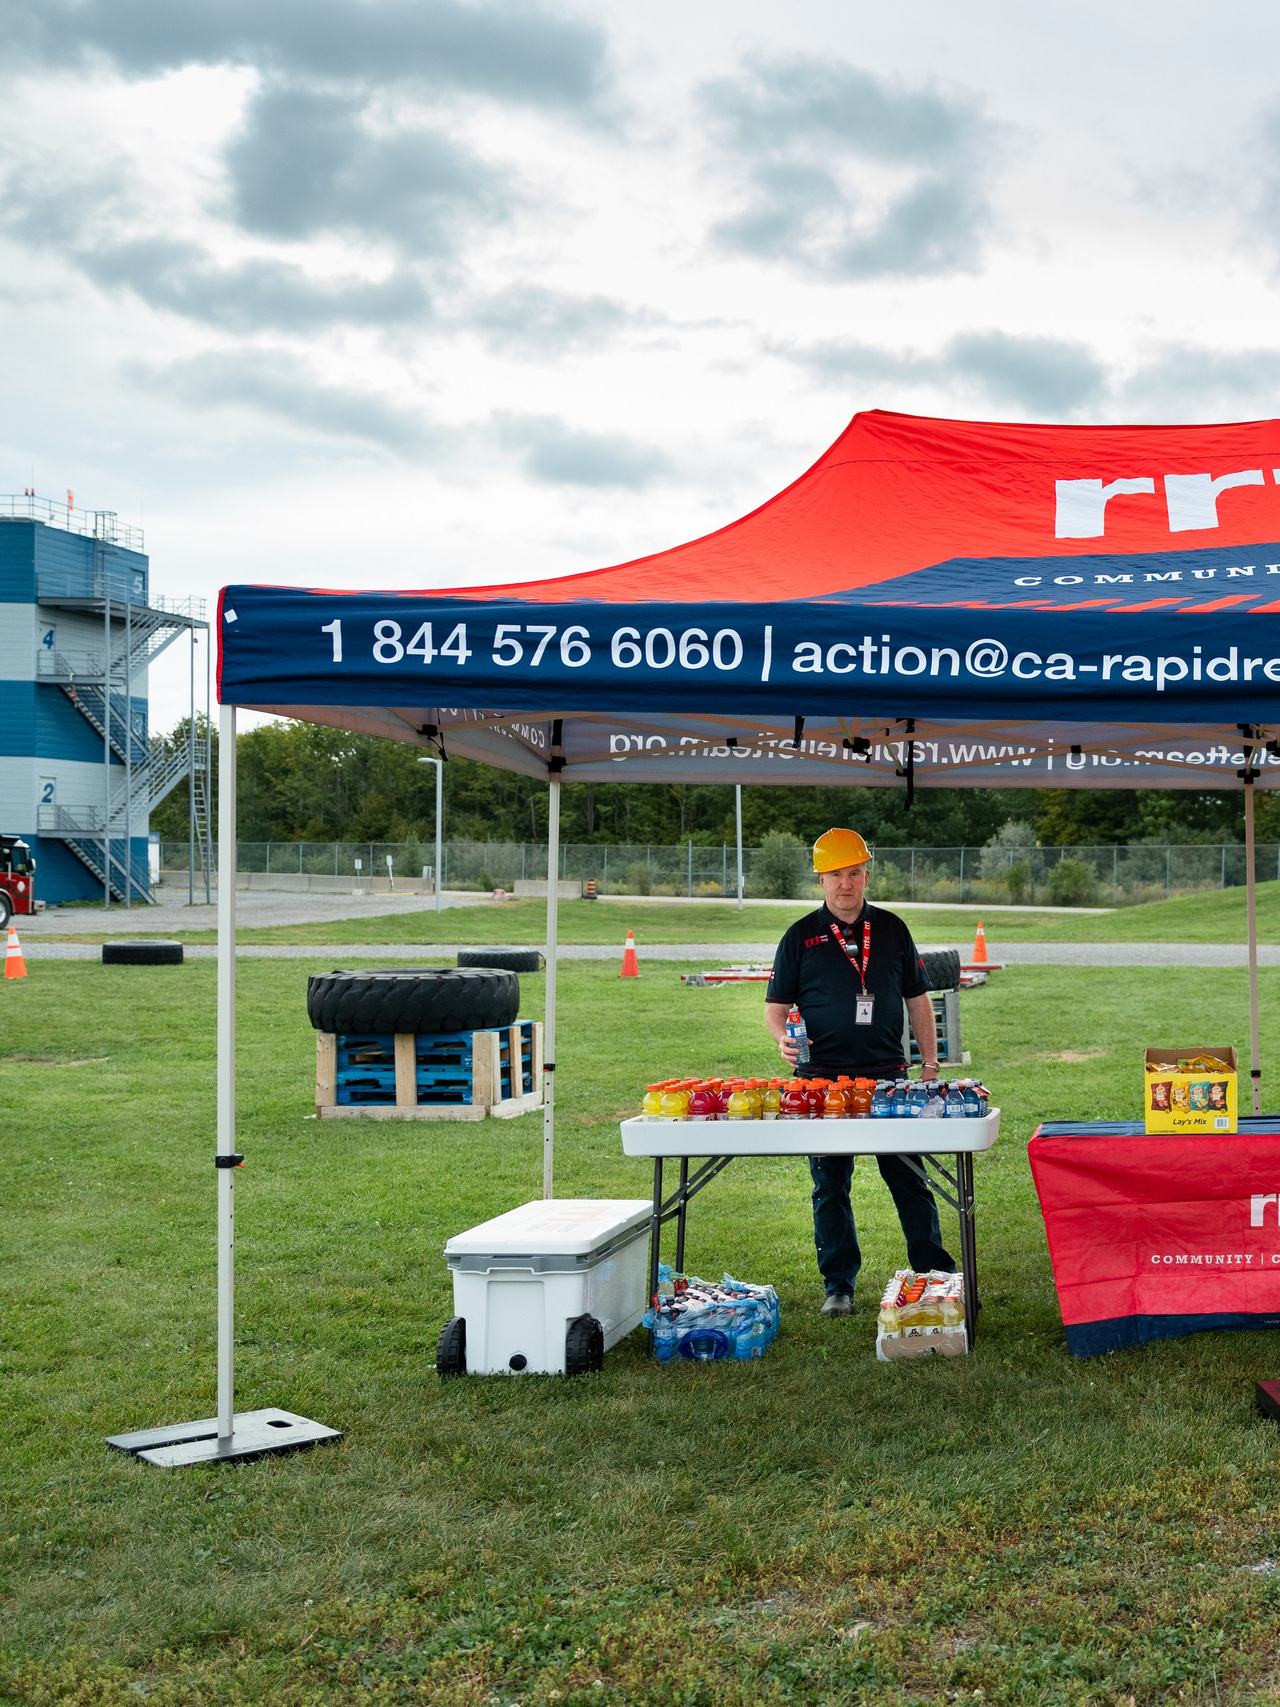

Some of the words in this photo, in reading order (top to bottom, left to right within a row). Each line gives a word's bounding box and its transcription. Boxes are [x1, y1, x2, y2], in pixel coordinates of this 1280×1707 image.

[133, 576, 143, 594] 5
[42, 629, 54, 649] 4
[321, 619, 343, 663] 1
[372, 619, 473, 665] 844
[491, 624, 592, 667] 576
[611, 626, 743, 670] 6060
[42, 783, 54, 803] 2
[1172, 1118, 1192, 1126] Lay's
[1150, 1253, 1254, 1265] COMMUNITY
